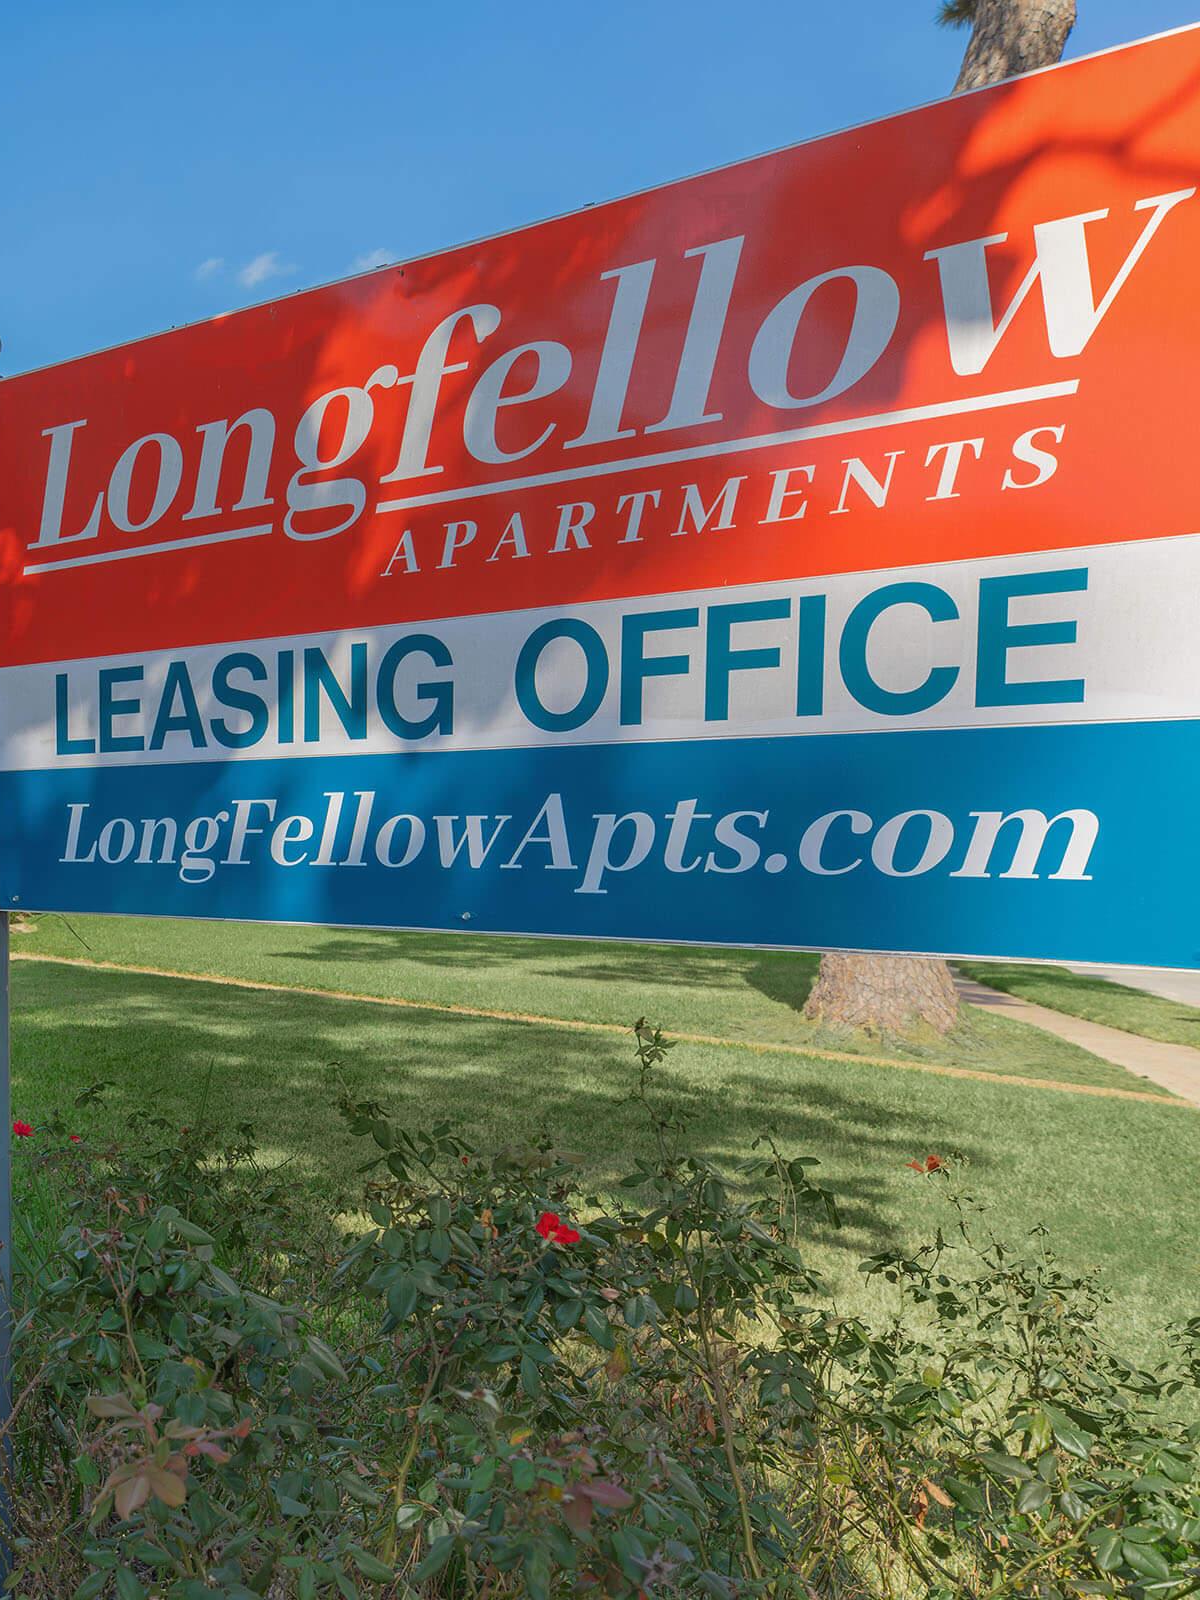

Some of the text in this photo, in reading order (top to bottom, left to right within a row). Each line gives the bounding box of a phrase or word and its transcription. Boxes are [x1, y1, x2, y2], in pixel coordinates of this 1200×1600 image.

[26, 186, 1197, 542] Longfellow
[380, 423, 1067, 577] APARTMENTS
[55, 567, 1089, 756] LEASING OFFICE
[58, 791, 1101, 894] LongFellowApts.com
